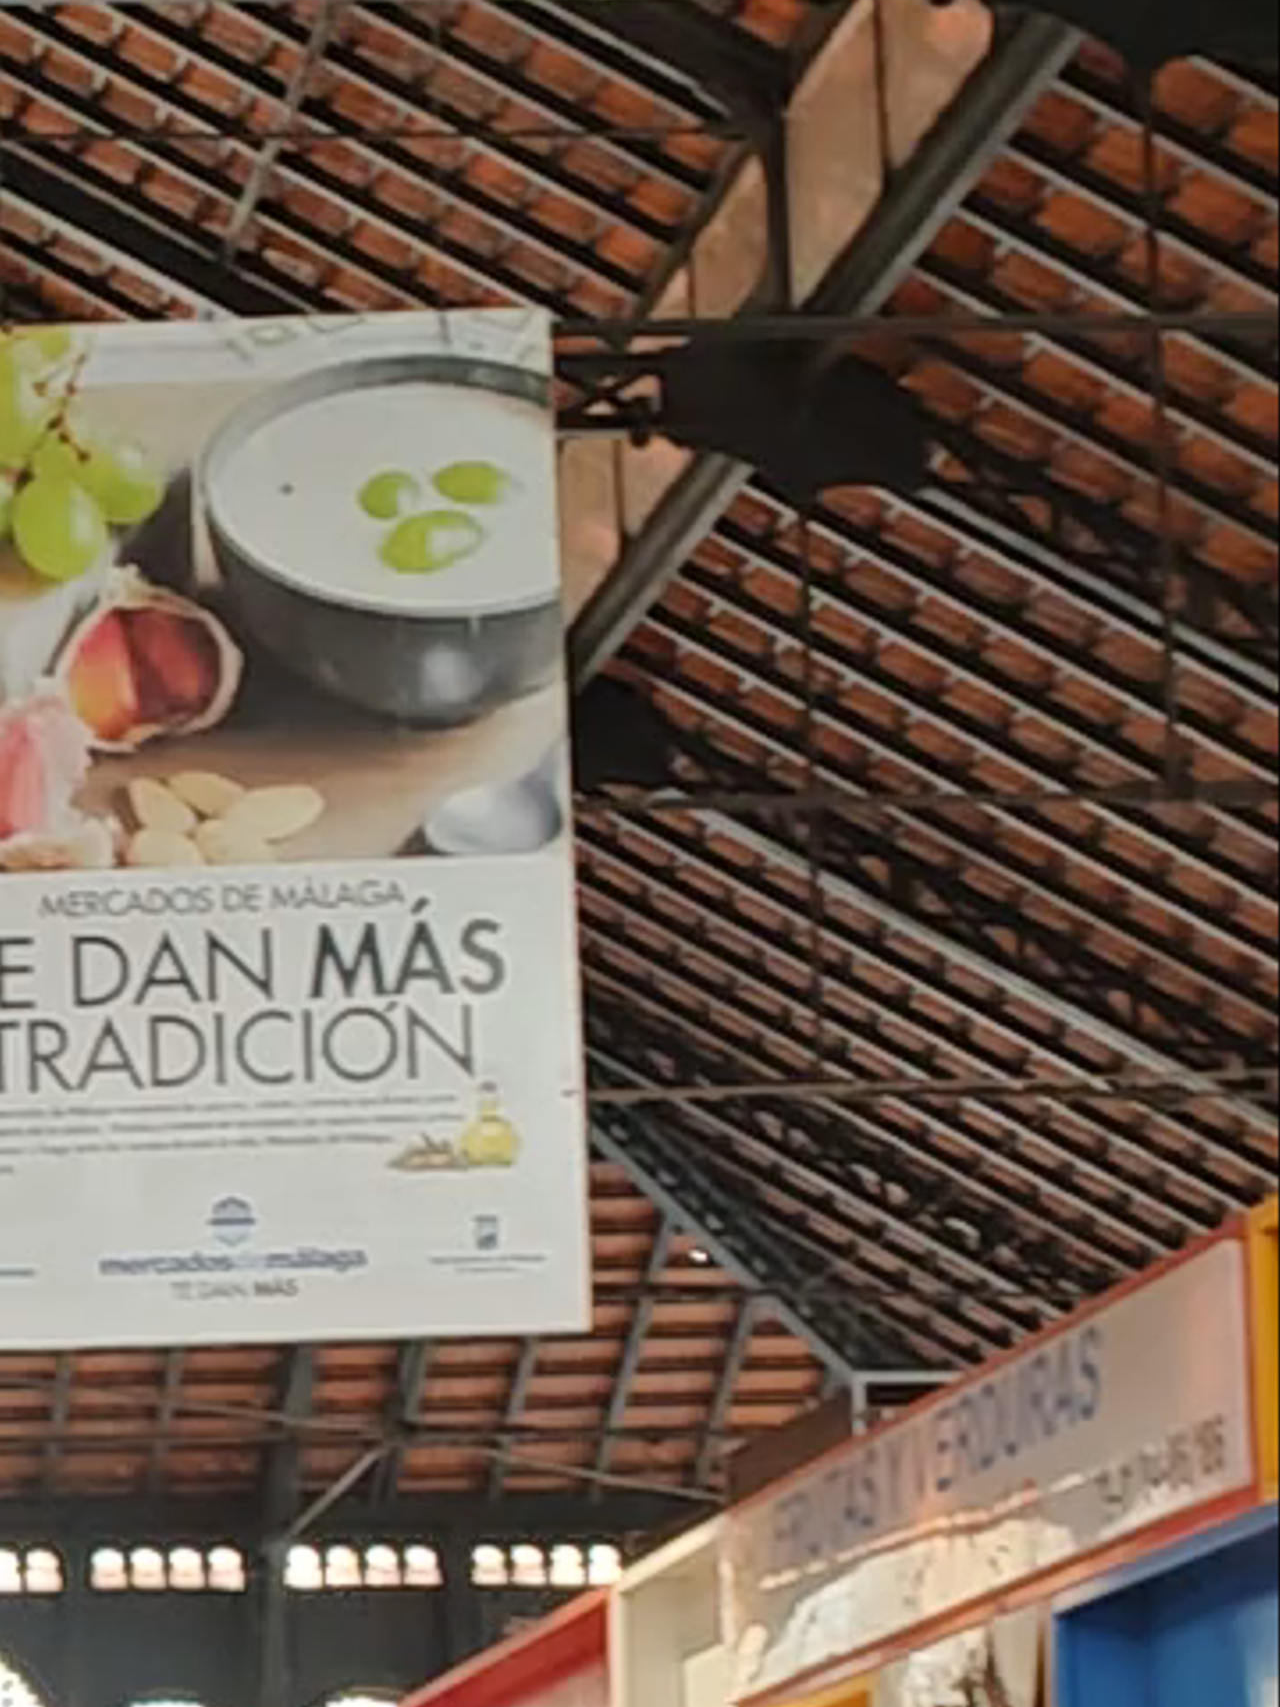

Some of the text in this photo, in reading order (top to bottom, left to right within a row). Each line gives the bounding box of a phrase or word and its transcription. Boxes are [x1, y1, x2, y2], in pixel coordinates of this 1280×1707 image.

[38, 879, 405, 919] MERCADOS DE MÁLAGA
[71, 927, 275, 1007] DAN
[306, 897, 507, 1000] MÁS
